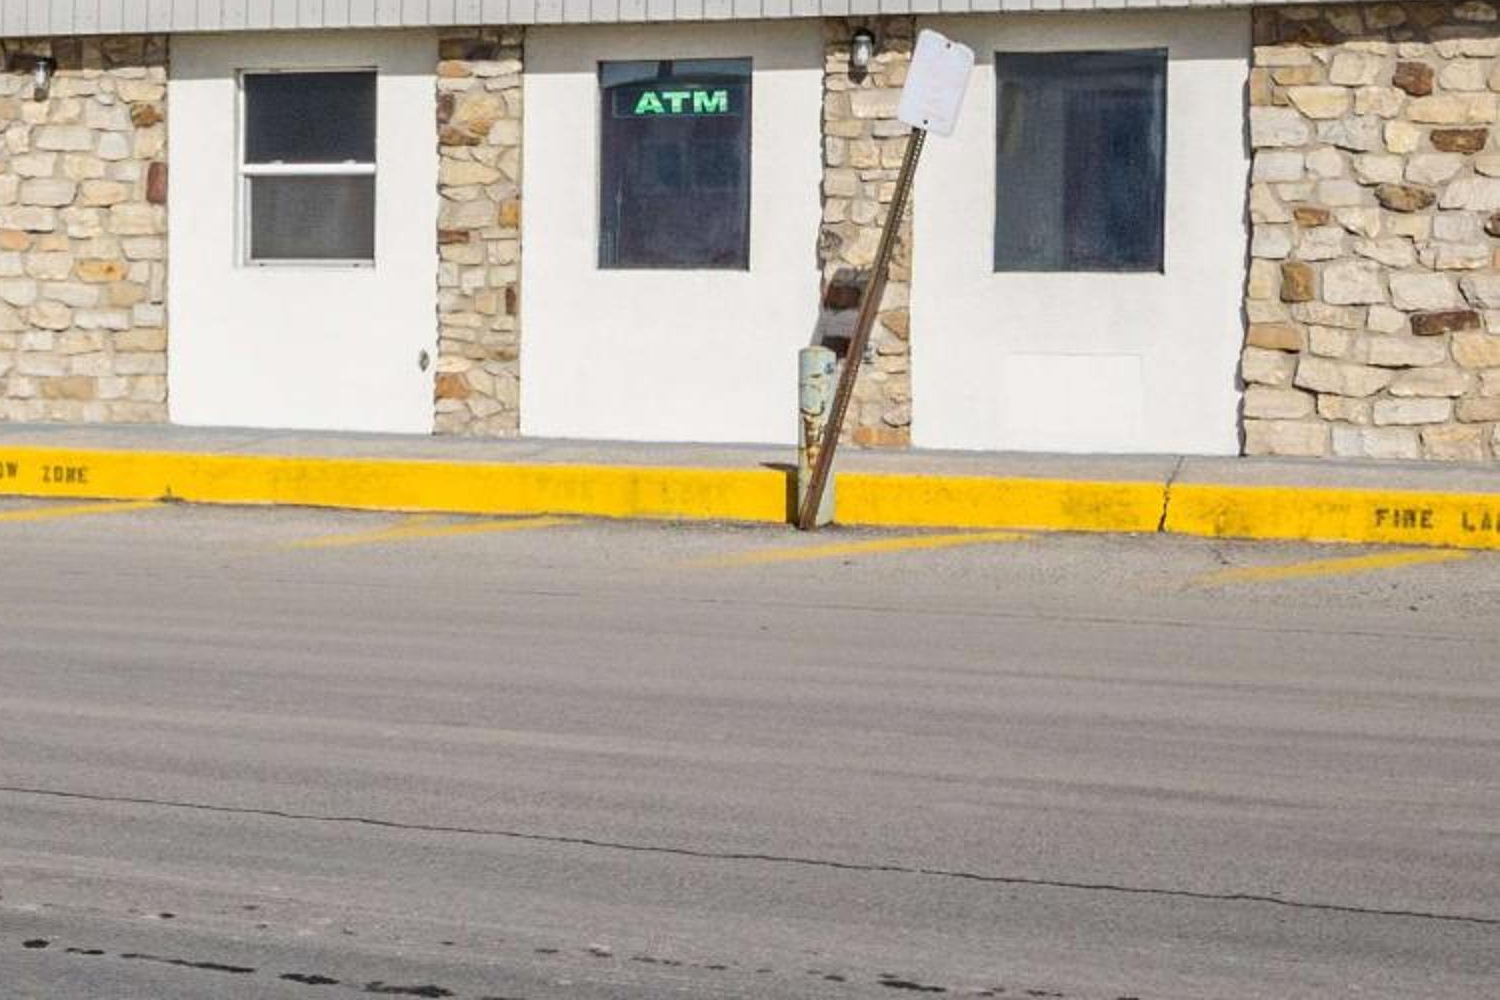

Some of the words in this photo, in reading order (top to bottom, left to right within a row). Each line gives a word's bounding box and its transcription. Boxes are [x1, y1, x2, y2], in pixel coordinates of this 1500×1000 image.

[634, 90, 729, 114] ATM
[41, 465, 89, 484] ZONE
[1375, 508, 1434, 529] FIRE
